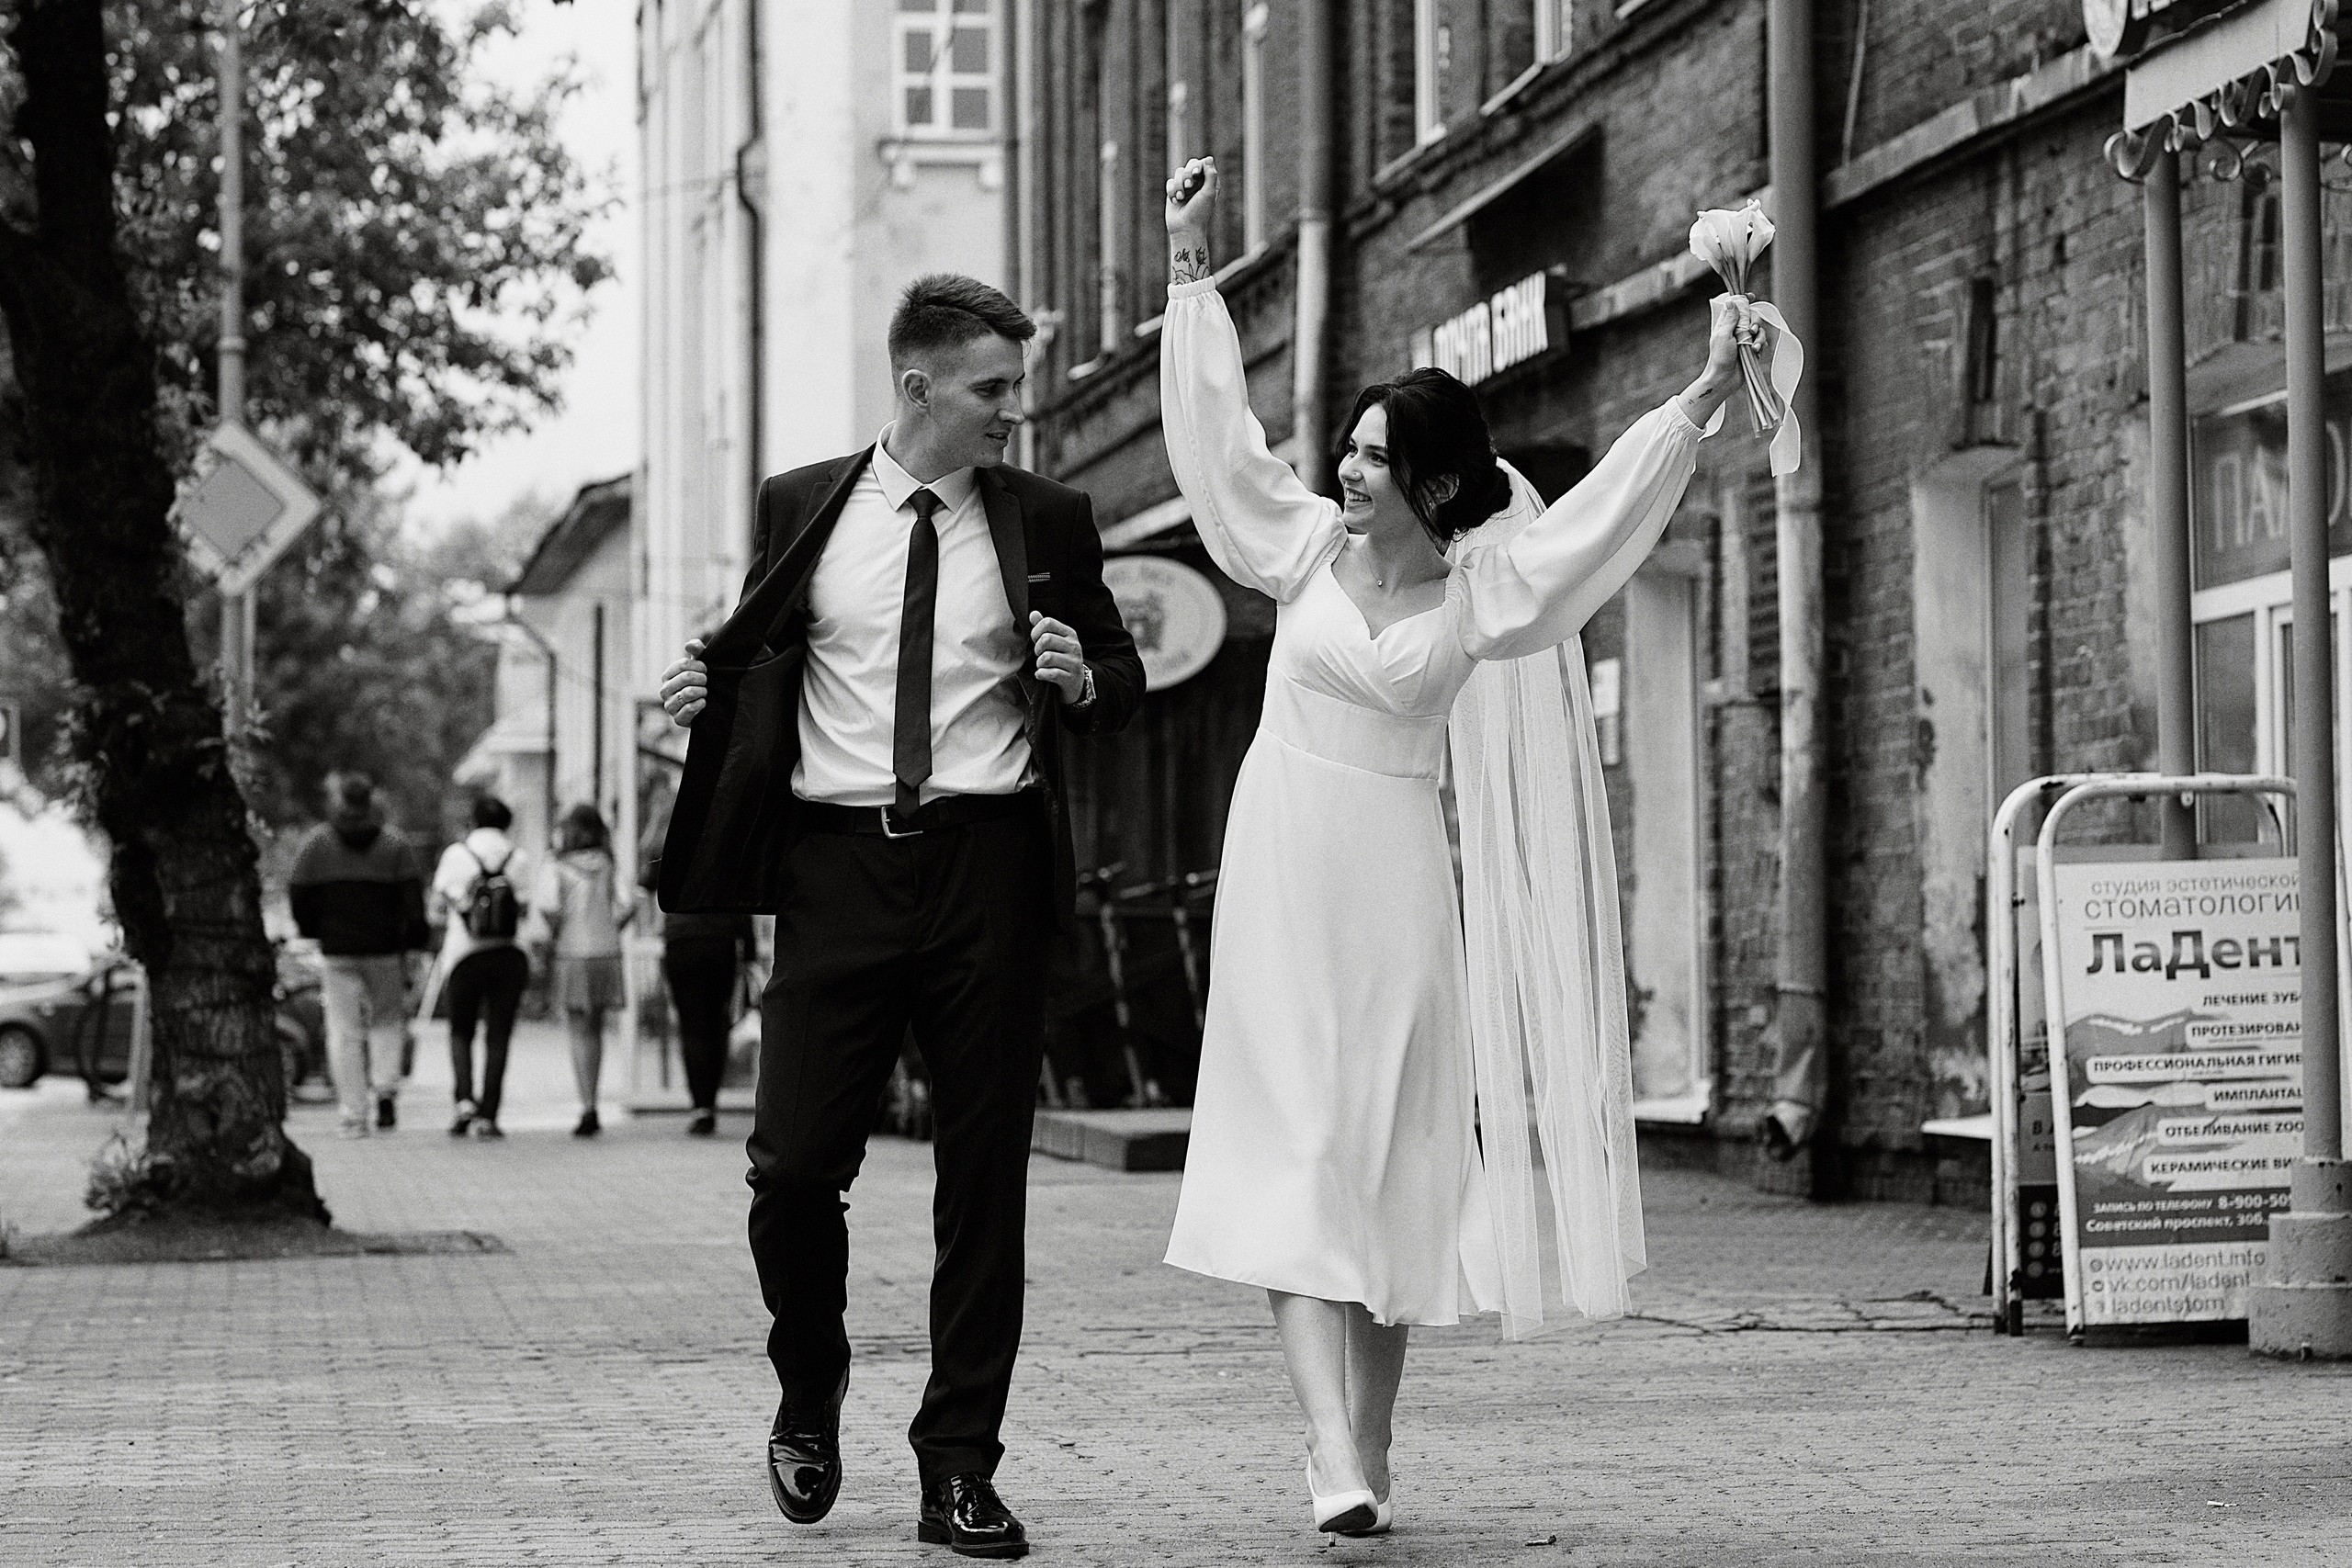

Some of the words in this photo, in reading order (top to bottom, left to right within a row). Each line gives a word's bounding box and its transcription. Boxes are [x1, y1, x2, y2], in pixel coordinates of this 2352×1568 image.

[2091, 878, 2161, 899] студия
[2084, 891, 2301, 920] стоматологи
[2086, 929, 2301, 981] ЛаДент
[2202, 993, 2269, 1008] ЛЕЧЕНИЕ
[2272, 991, 2301, 1004] ЗУБ
[2093, 1054, 2256, 1073] ПРОФЕССИОНАЛЬНАЯ
[2165, 1122, 2270, 1138] ОТБЕЛИВАНИЕ
[2151, 1158, 2270, 1174] КЕРАМИЧЕСКИЕ
[2093, 1201, 2137, 1213] ЗАПИСЬ
[2136, 1201, 2154, 1212] ПО
[2154, 1198, 2213, 1212] ТЕЛЕФОНУ
[2217, 1193, 2292, 1211] 8-900-50
[2086, 1216, 2162, 1233] Советский
